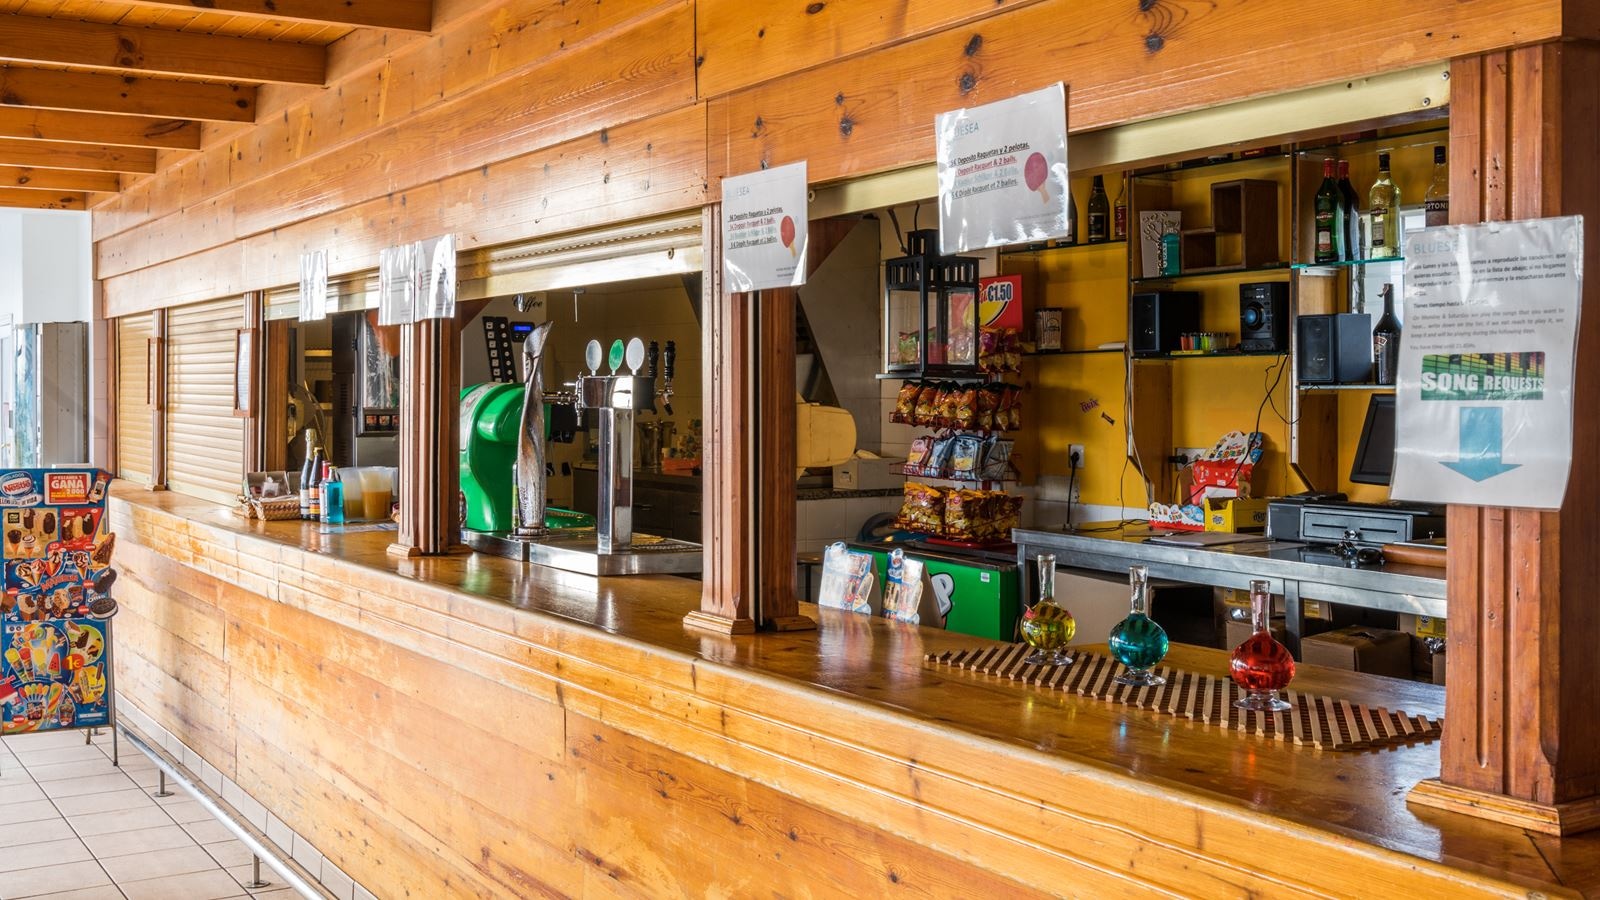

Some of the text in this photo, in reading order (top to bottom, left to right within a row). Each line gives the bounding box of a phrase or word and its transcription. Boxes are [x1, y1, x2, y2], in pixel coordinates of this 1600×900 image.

[974, 160, 992, 171] Racquet
[512, 294, 543, 312] Cffee
[1421, 372, 1544, 392] SONG REQUESTS
[51, 480, 84, 489] GANA
